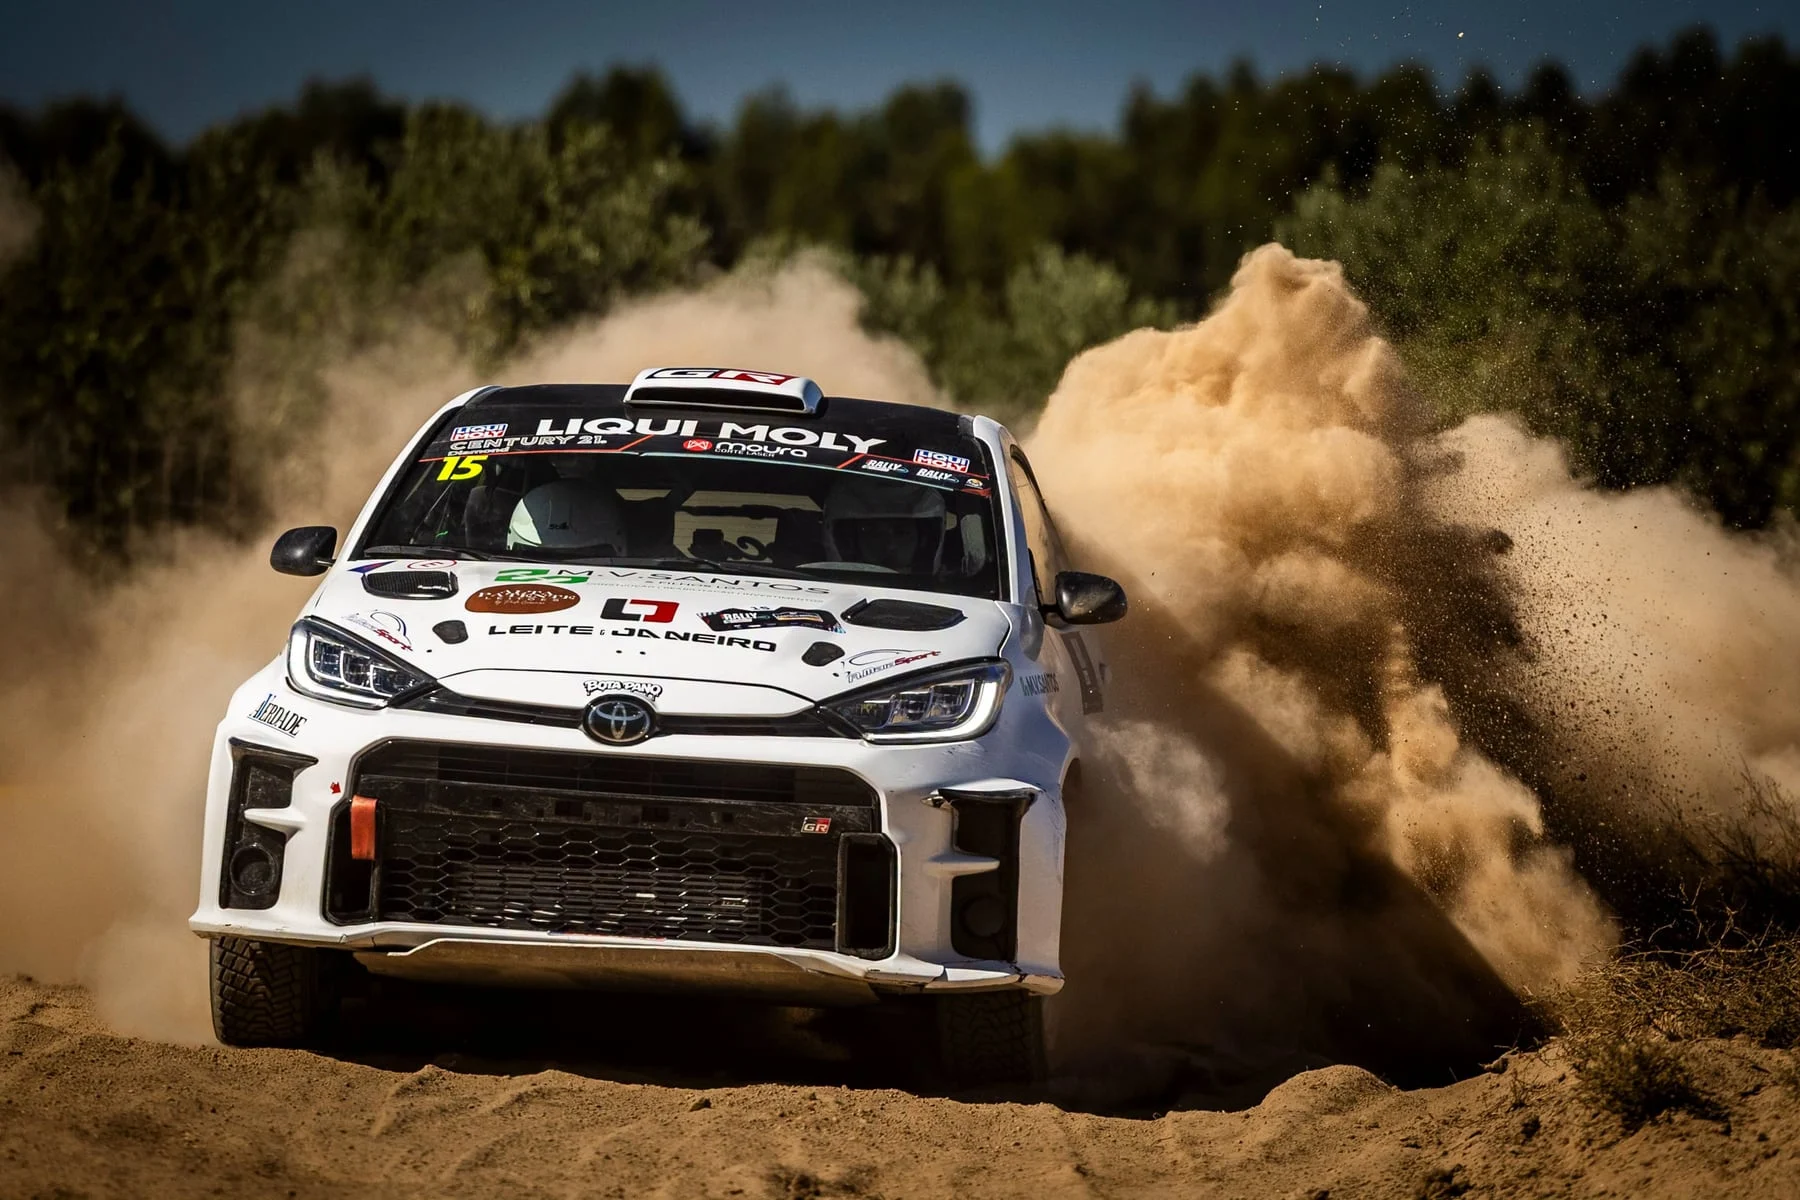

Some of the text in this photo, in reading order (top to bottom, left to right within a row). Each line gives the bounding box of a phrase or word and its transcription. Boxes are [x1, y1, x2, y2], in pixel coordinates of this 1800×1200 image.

[652, 369, 786, 384] GR
[455, 424, 504, 434] LIQUI
[456, 432, 501, 440] MOLY
[535, 417, 888, 454] LIQUI MOLY
[450, 435, 575, 450] CENTURY
[715, 441, 808, 458] moura
[447, 446, 510, 457] Diamond
[918, 449, 969, 466] LIQUI
[436, 454, 489, 481] 15
[866, 459, 902, 471] RALLY
[916, 456, 967, 472] MOLY
[916, 468, 953, 480] RALLY
[723, 612, 758, 622] RALLY
[488, 625, 594, 636] LEITE
[611, 627, 777, 653] JANEIRO
[894, 650, 941, 666] Sport
[583, 680, 663, 701] BOTA PANO
[803, 823, 829, 832] GR
